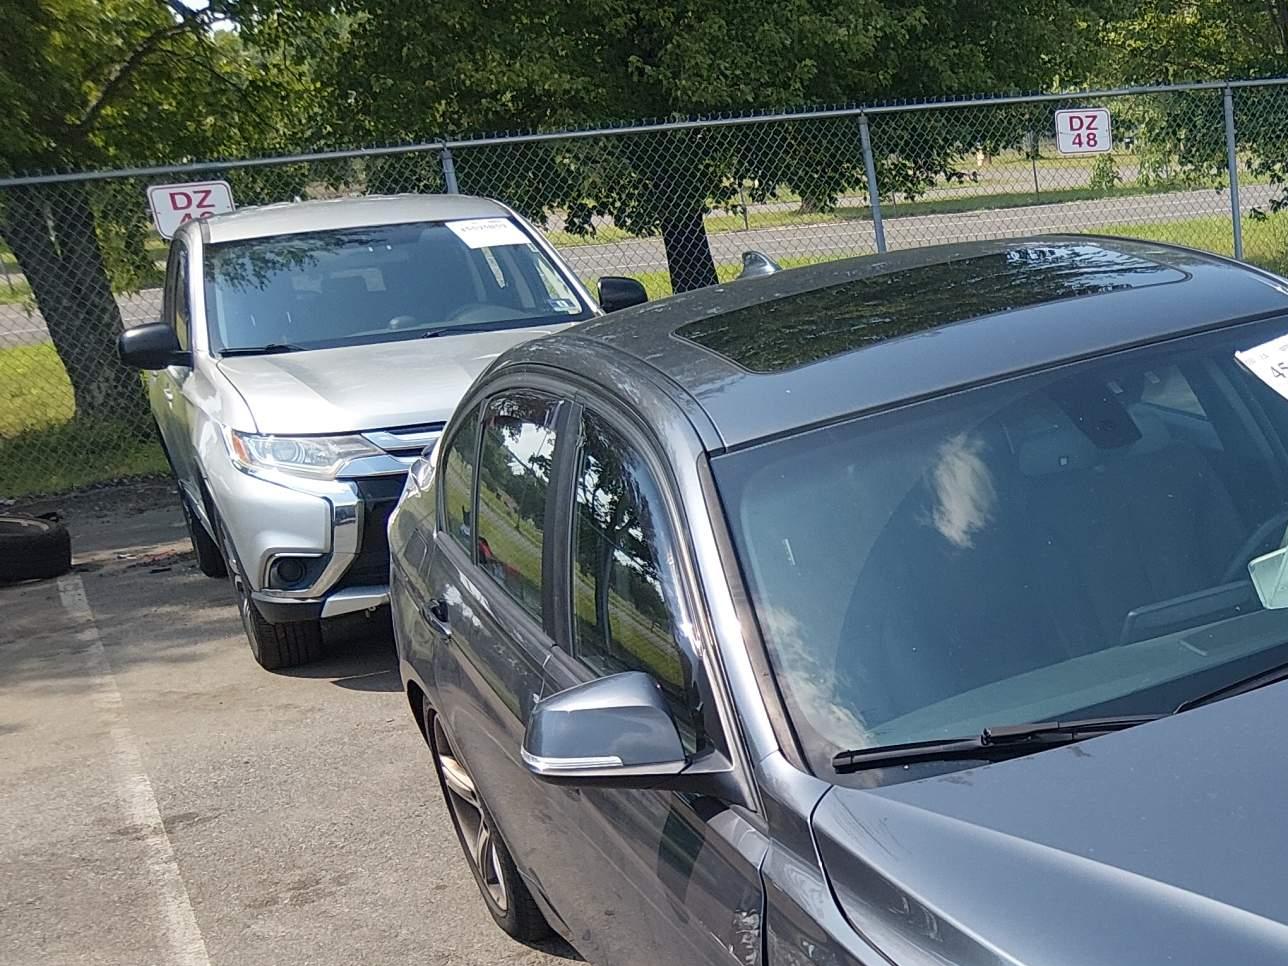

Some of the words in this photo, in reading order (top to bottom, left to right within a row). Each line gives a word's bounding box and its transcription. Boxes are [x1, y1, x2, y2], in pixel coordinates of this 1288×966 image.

[1068, 114, 1099, 132] DZ
[1071, 132, 1098, 148] 48
[168, 189, 216, 211] DZ
